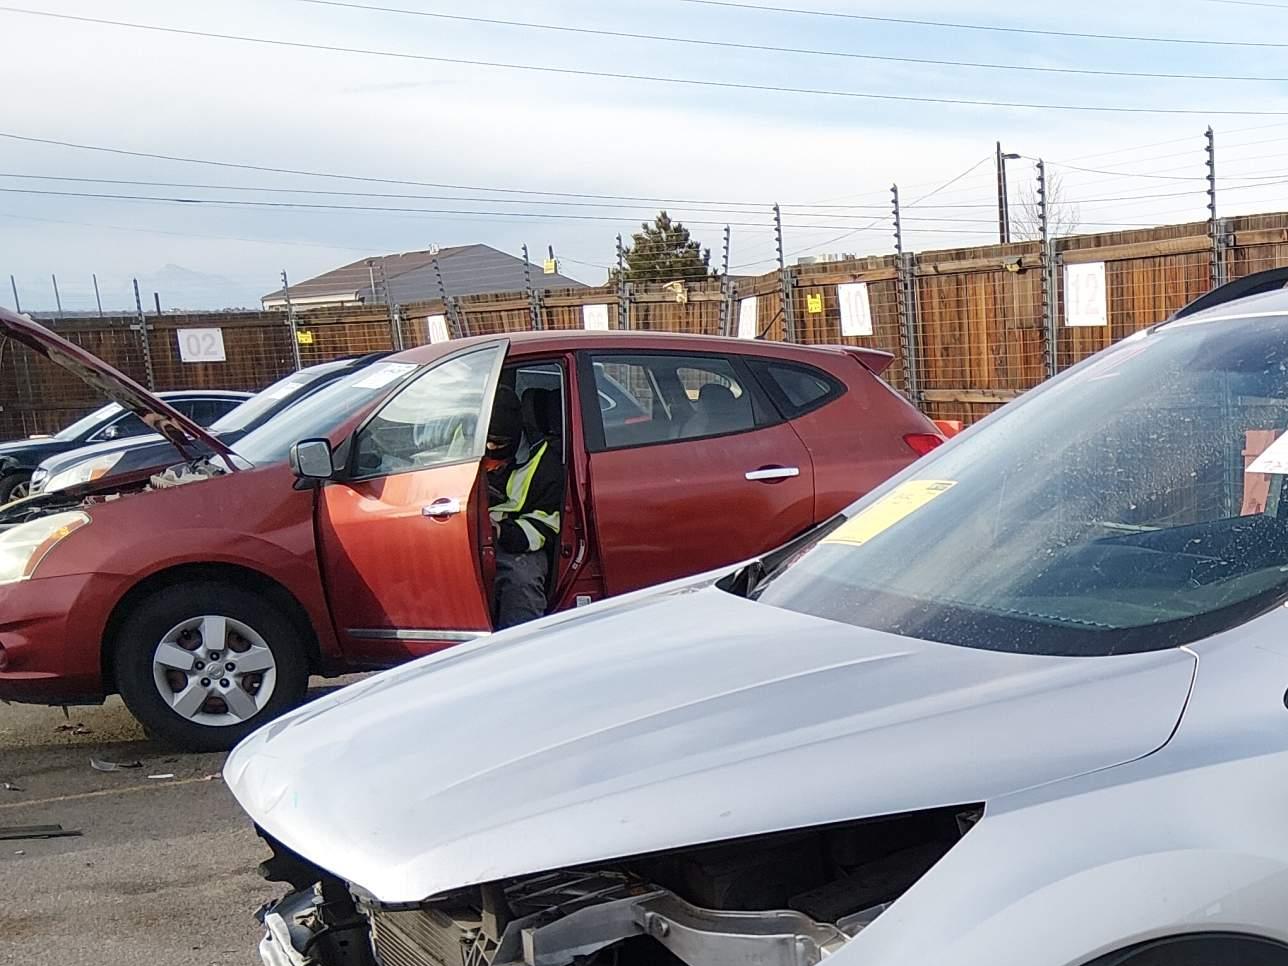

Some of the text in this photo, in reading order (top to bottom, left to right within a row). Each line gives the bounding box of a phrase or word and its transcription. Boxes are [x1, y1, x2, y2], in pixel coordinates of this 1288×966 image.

[844, 290, 866, 327] 10
[1072, 273, 1100, 316] 12
[185, 332, 218, 357] 02
